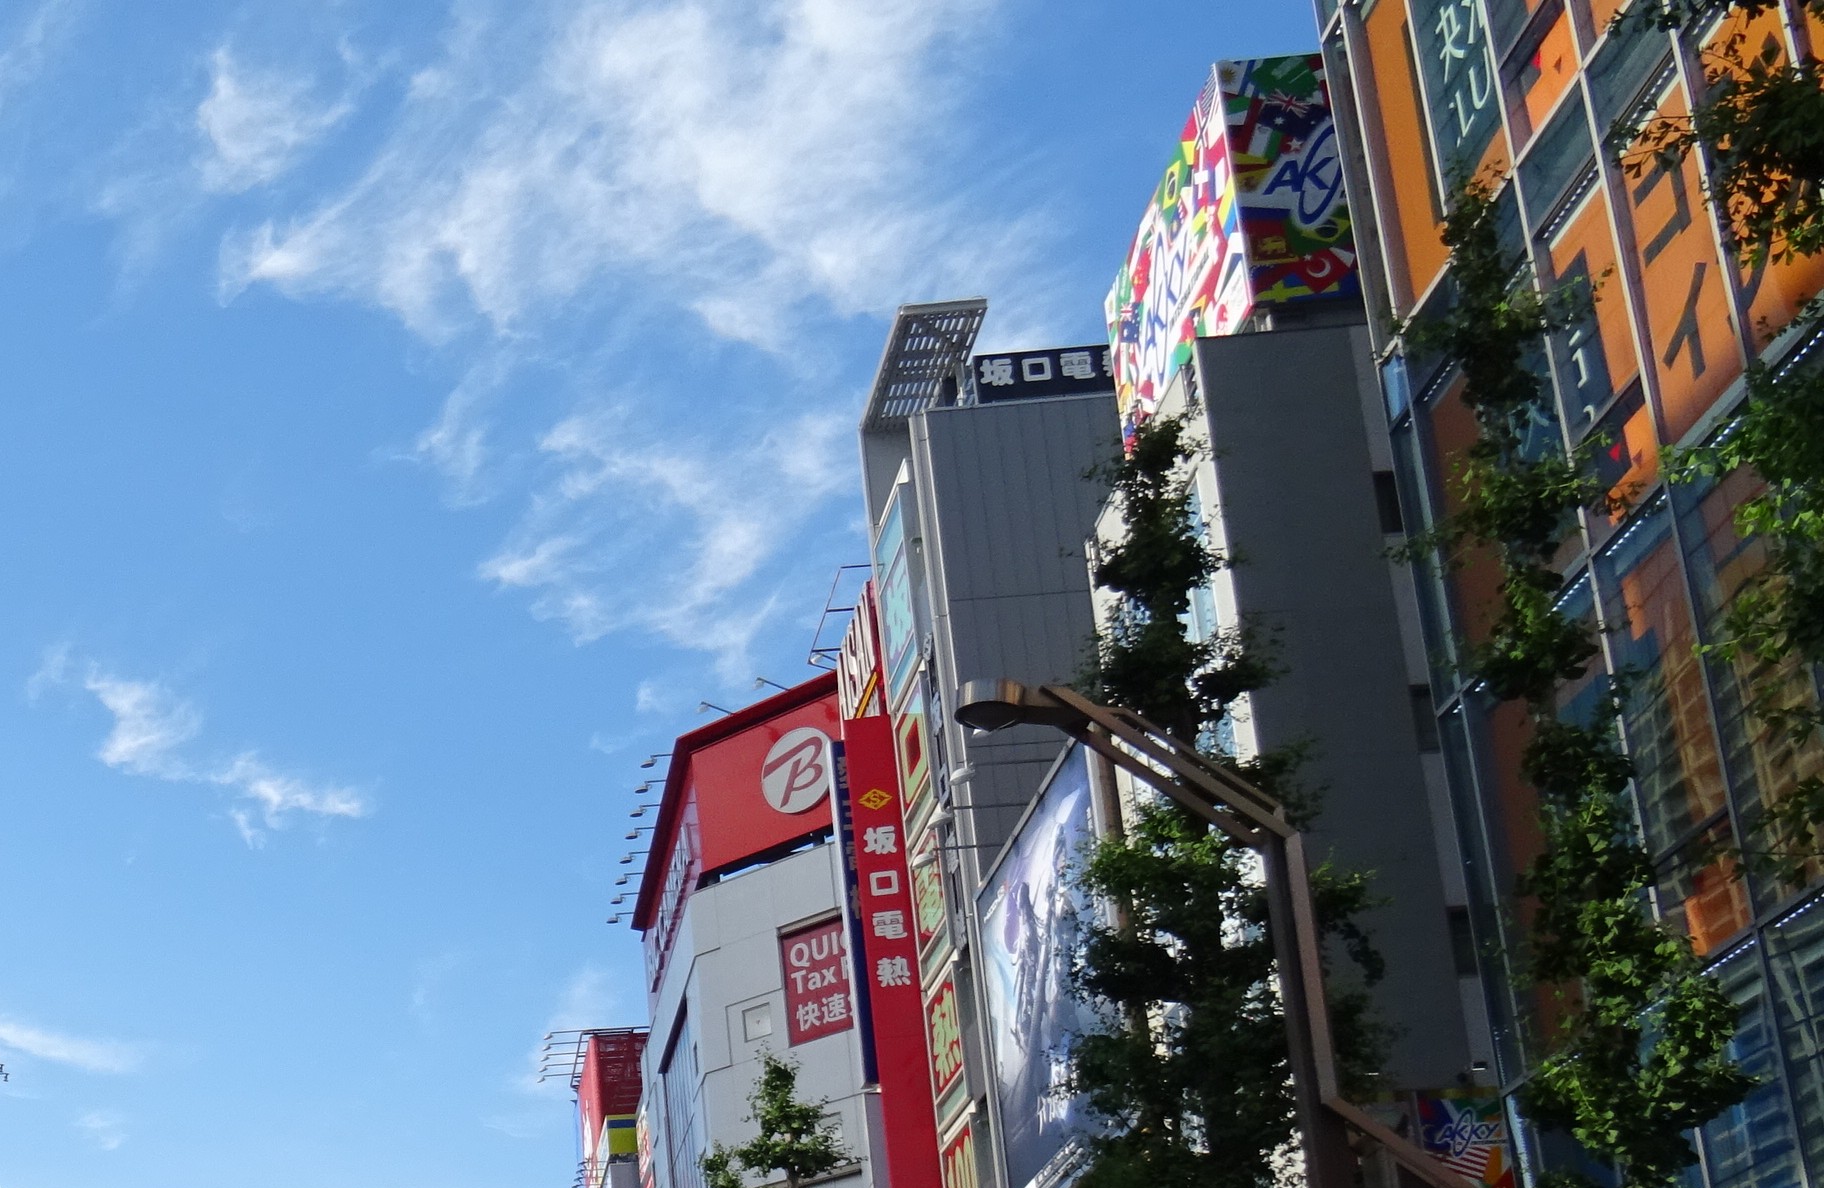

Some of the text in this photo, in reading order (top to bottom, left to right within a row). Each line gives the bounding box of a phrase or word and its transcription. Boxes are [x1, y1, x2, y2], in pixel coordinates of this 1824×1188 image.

[863, 825, 912, 989] 坂口電熱
[790, 955, 838, 995] Tax
[795, 993, 853, 1032] 快速
